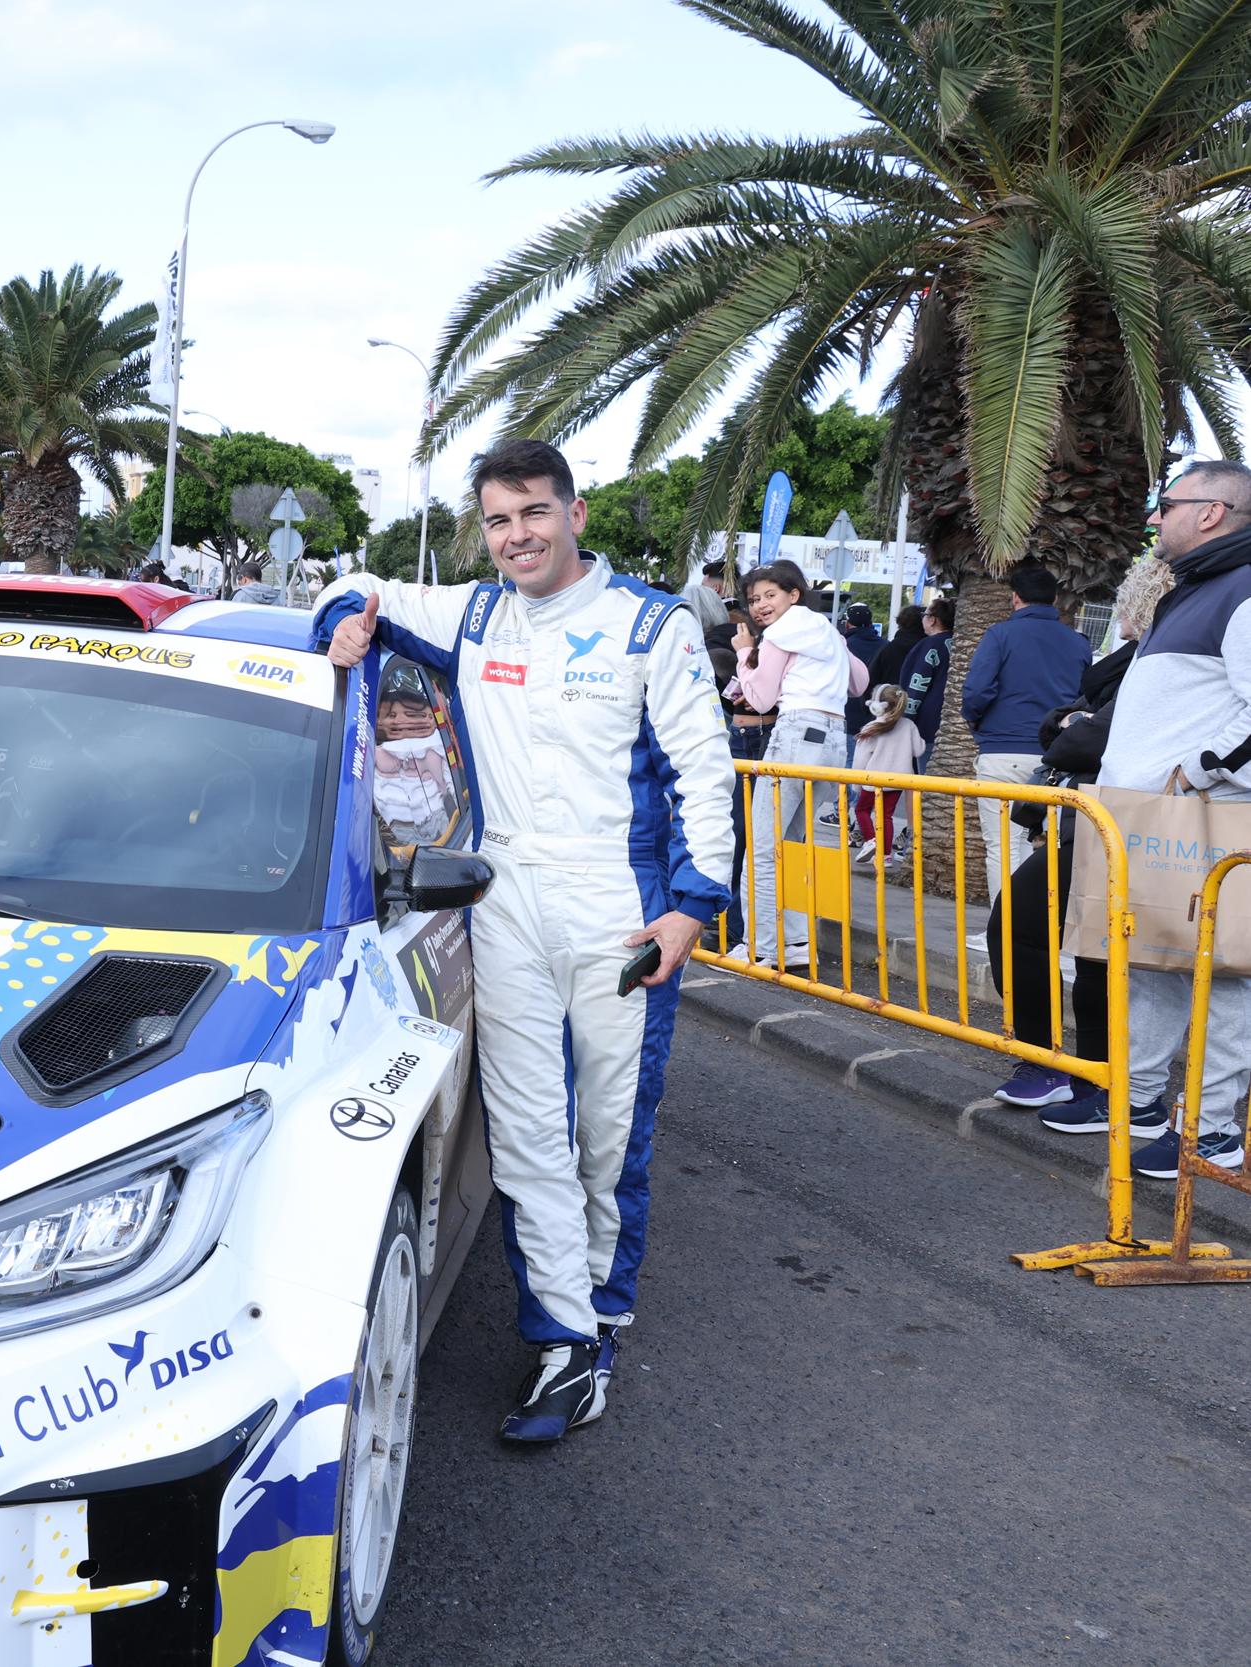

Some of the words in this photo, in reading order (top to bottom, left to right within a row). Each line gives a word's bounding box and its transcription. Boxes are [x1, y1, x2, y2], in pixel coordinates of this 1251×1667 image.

[803, 543, 880, 572] LANOTE
[471, 591, 491, 633] sparco
[634, 602, 664, 645] sparco
[30, 633, 194, 670] PARQUE
[240, 659, 294, 684] NAPA
[488, 666, 522, 681] worten
[564, 671, 615, 684] DISA
[586, 692, 619, 702] Canarias
[483, 829, 510, 846] sparco
[1145, 860, 1170, 871] LOVE
[1174, 863, 1193, 872] THE
[369, 1051, 421, 1096] Canarias
[150, 1329, 234, 1390] DISA
[14, 1365, 119, 1442] Club
